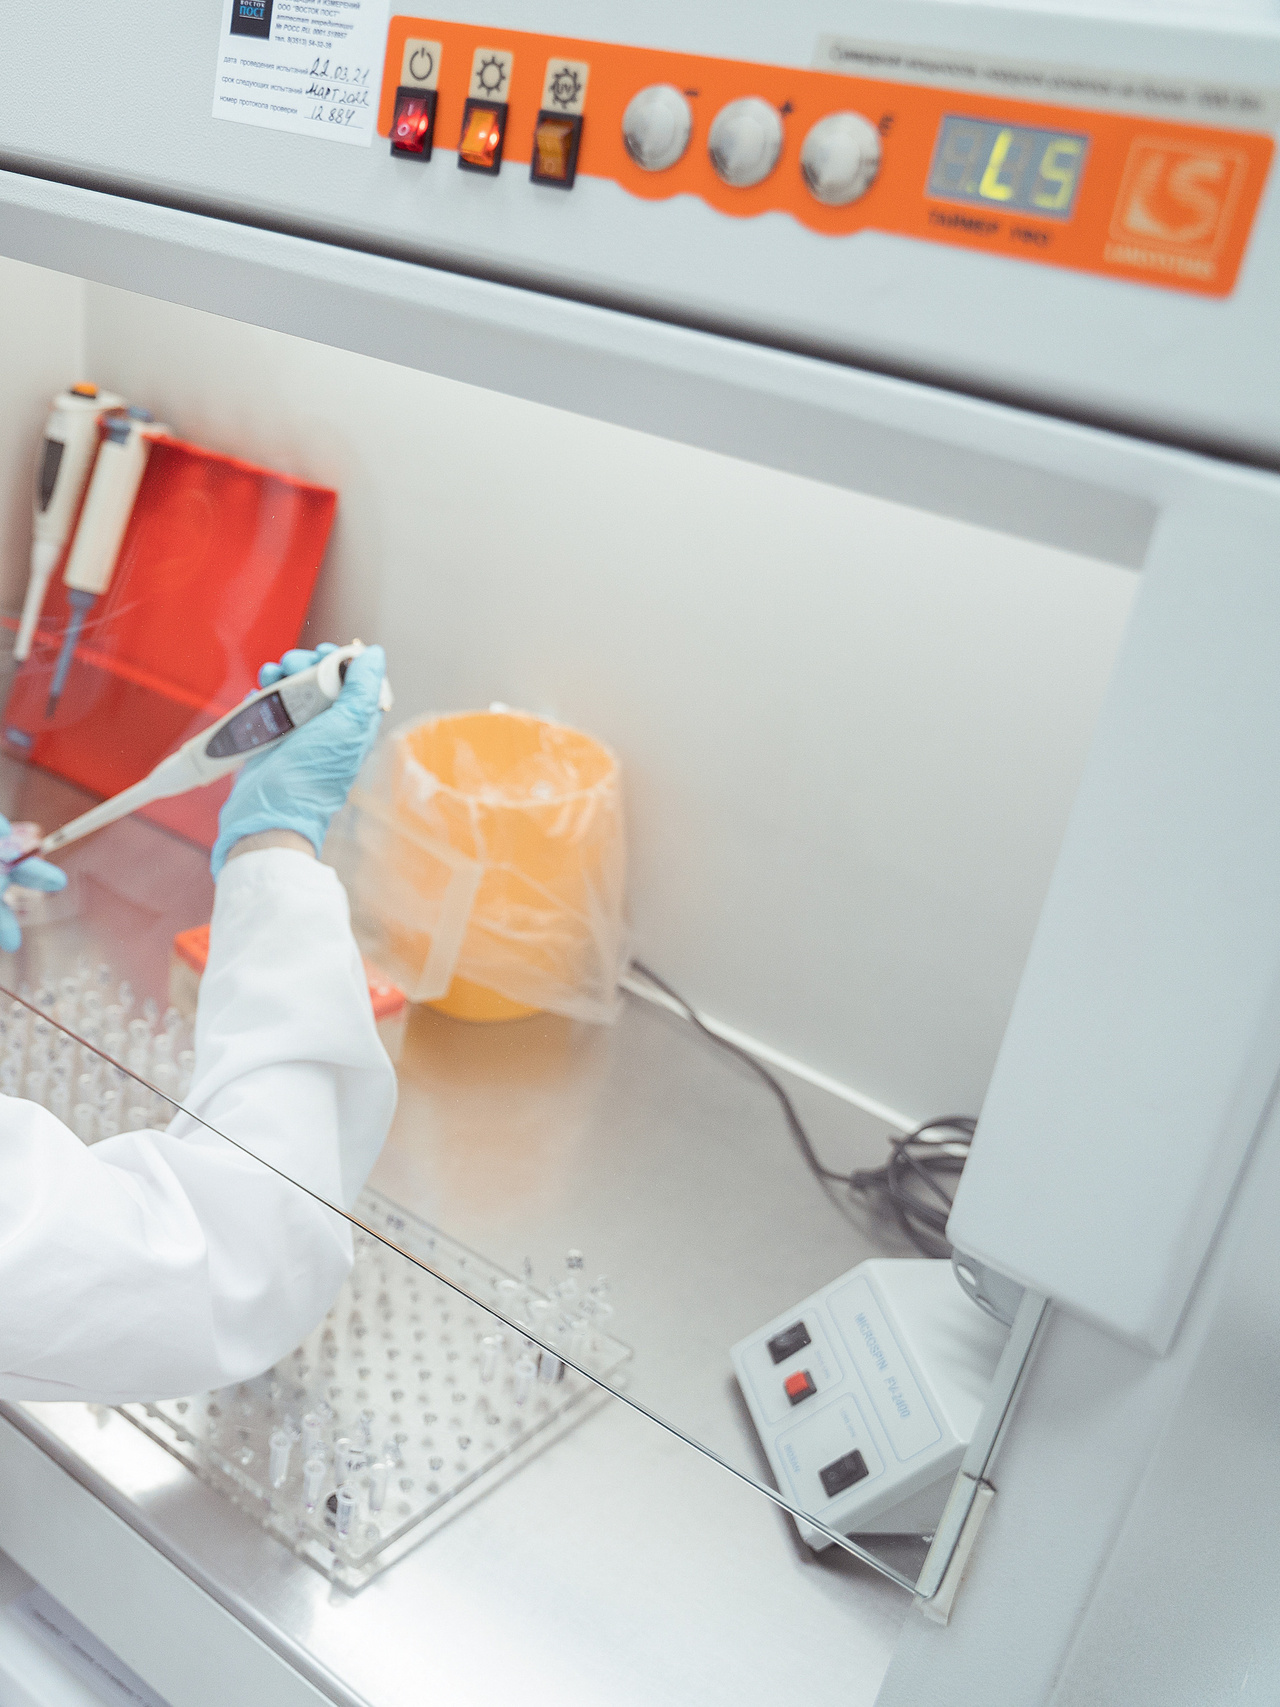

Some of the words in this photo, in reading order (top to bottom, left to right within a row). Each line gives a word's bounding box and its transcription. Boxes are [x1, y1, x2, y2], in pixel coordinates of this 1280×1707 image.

[239, 6, 265, 17] ПОСТ
[277, 3, 291, 11] ООО
[240, 59, 275, 69] проведения
[276, 65, 308, 74] испытаний
[221, 76, 234, 84] срок
[235, 78, 269, 89] следующих
[270, 84, 303, 94] испытаний
[220, 96, 238, 105] номер
[239, 98, 269, 110] протокола
[270, 104, 298, 115] проверки
[855, 1312, 888, 1372] MICROSPIN
